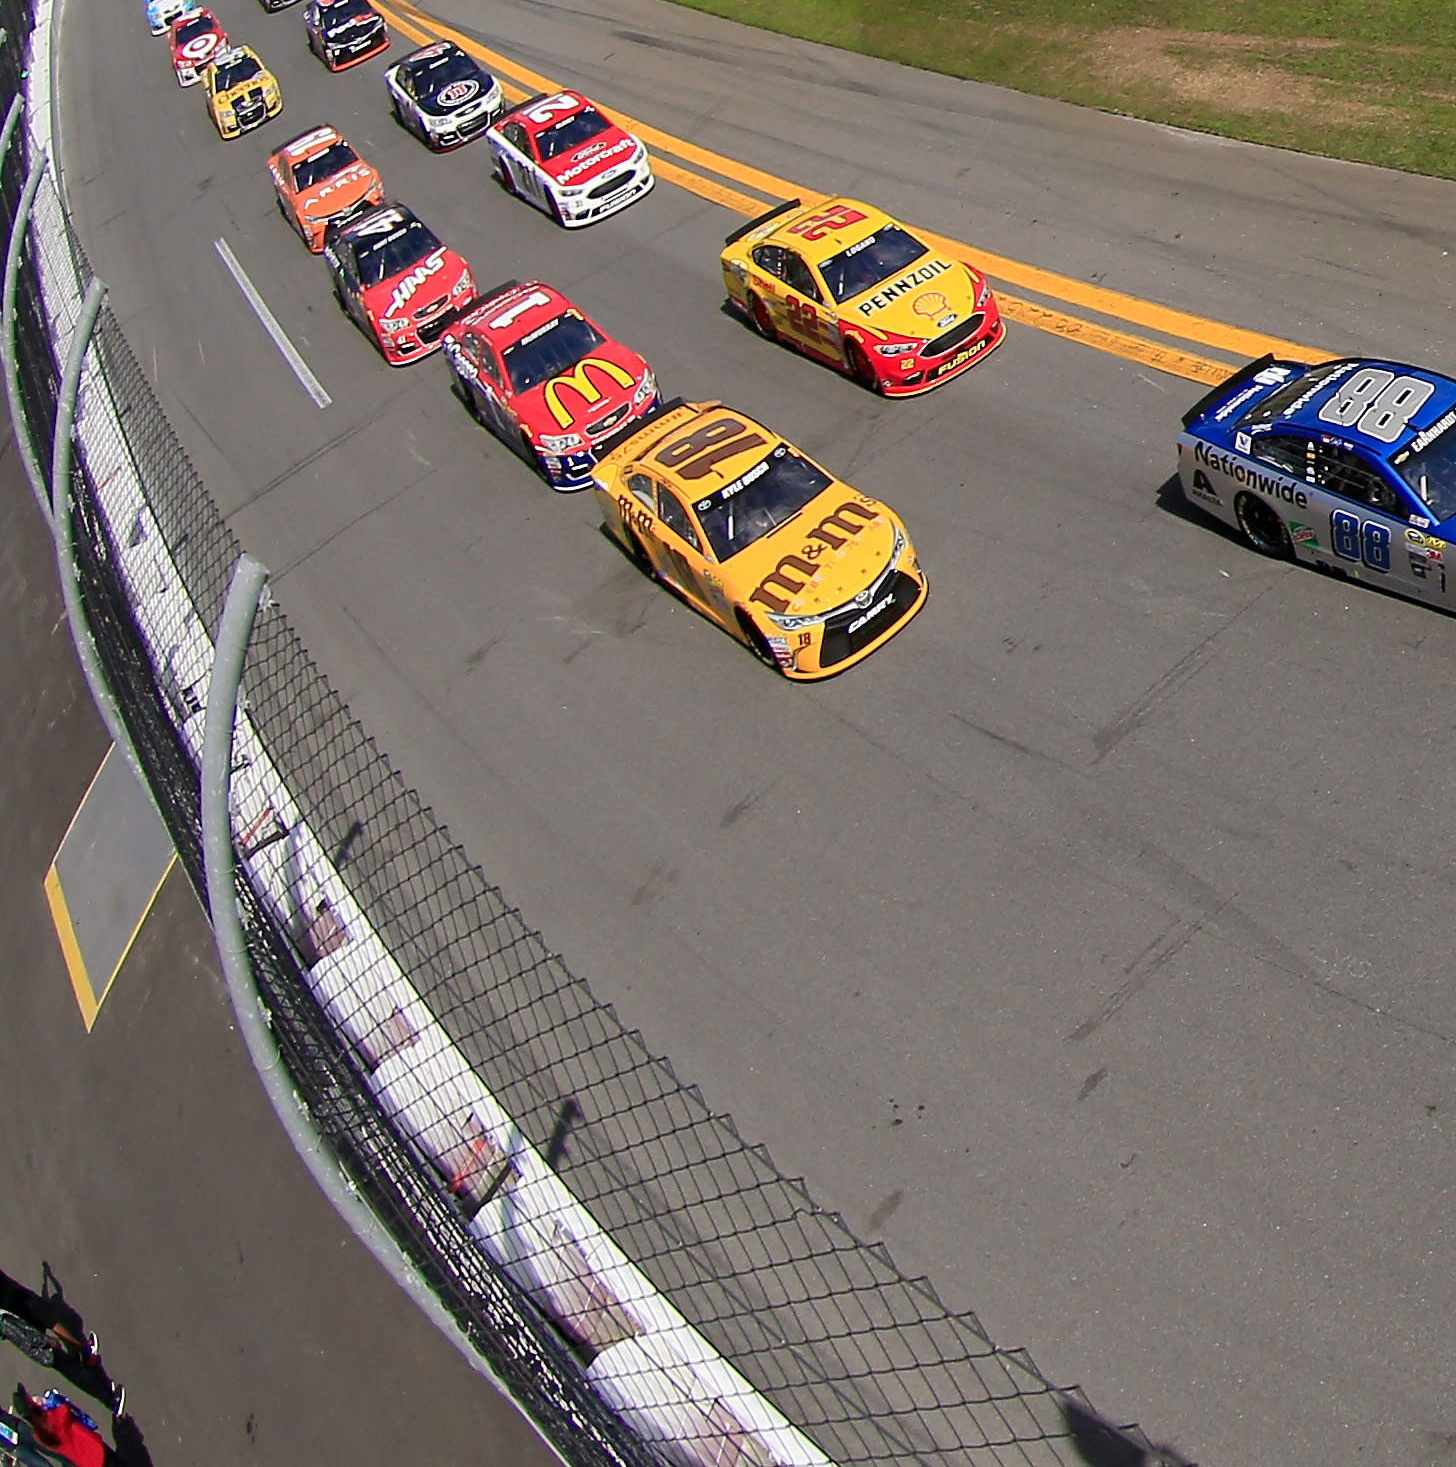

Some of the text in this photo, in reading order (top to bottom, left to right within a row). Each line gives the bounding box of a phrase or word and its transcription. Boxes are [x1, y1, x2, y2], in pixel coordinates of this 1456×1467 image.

[218, 73, 269, 105] Cheerios
[555, 136, 636, 186] Motorcraft
[304, 167, 372, 210] ARRIS
[785, 204, 870, 242] 22
[844, 236, 877, 258] LOGANO
[856, 259, 953, 318] PENNZOIL
[900, 358, 915, 371] 22
[937, 338, 987, 376] FUSION
[1317, 367, 1436, 443] 88
[655, 417, 768, 481] 18
[1194, 440, 1308, 509] Nationwide
[1331, 508, 1392, 573] 88
[1426, 548, 1443, 562] 3M
[847, 593, 894, 634] CAMRY
[798, 632, 811, 647] 18
